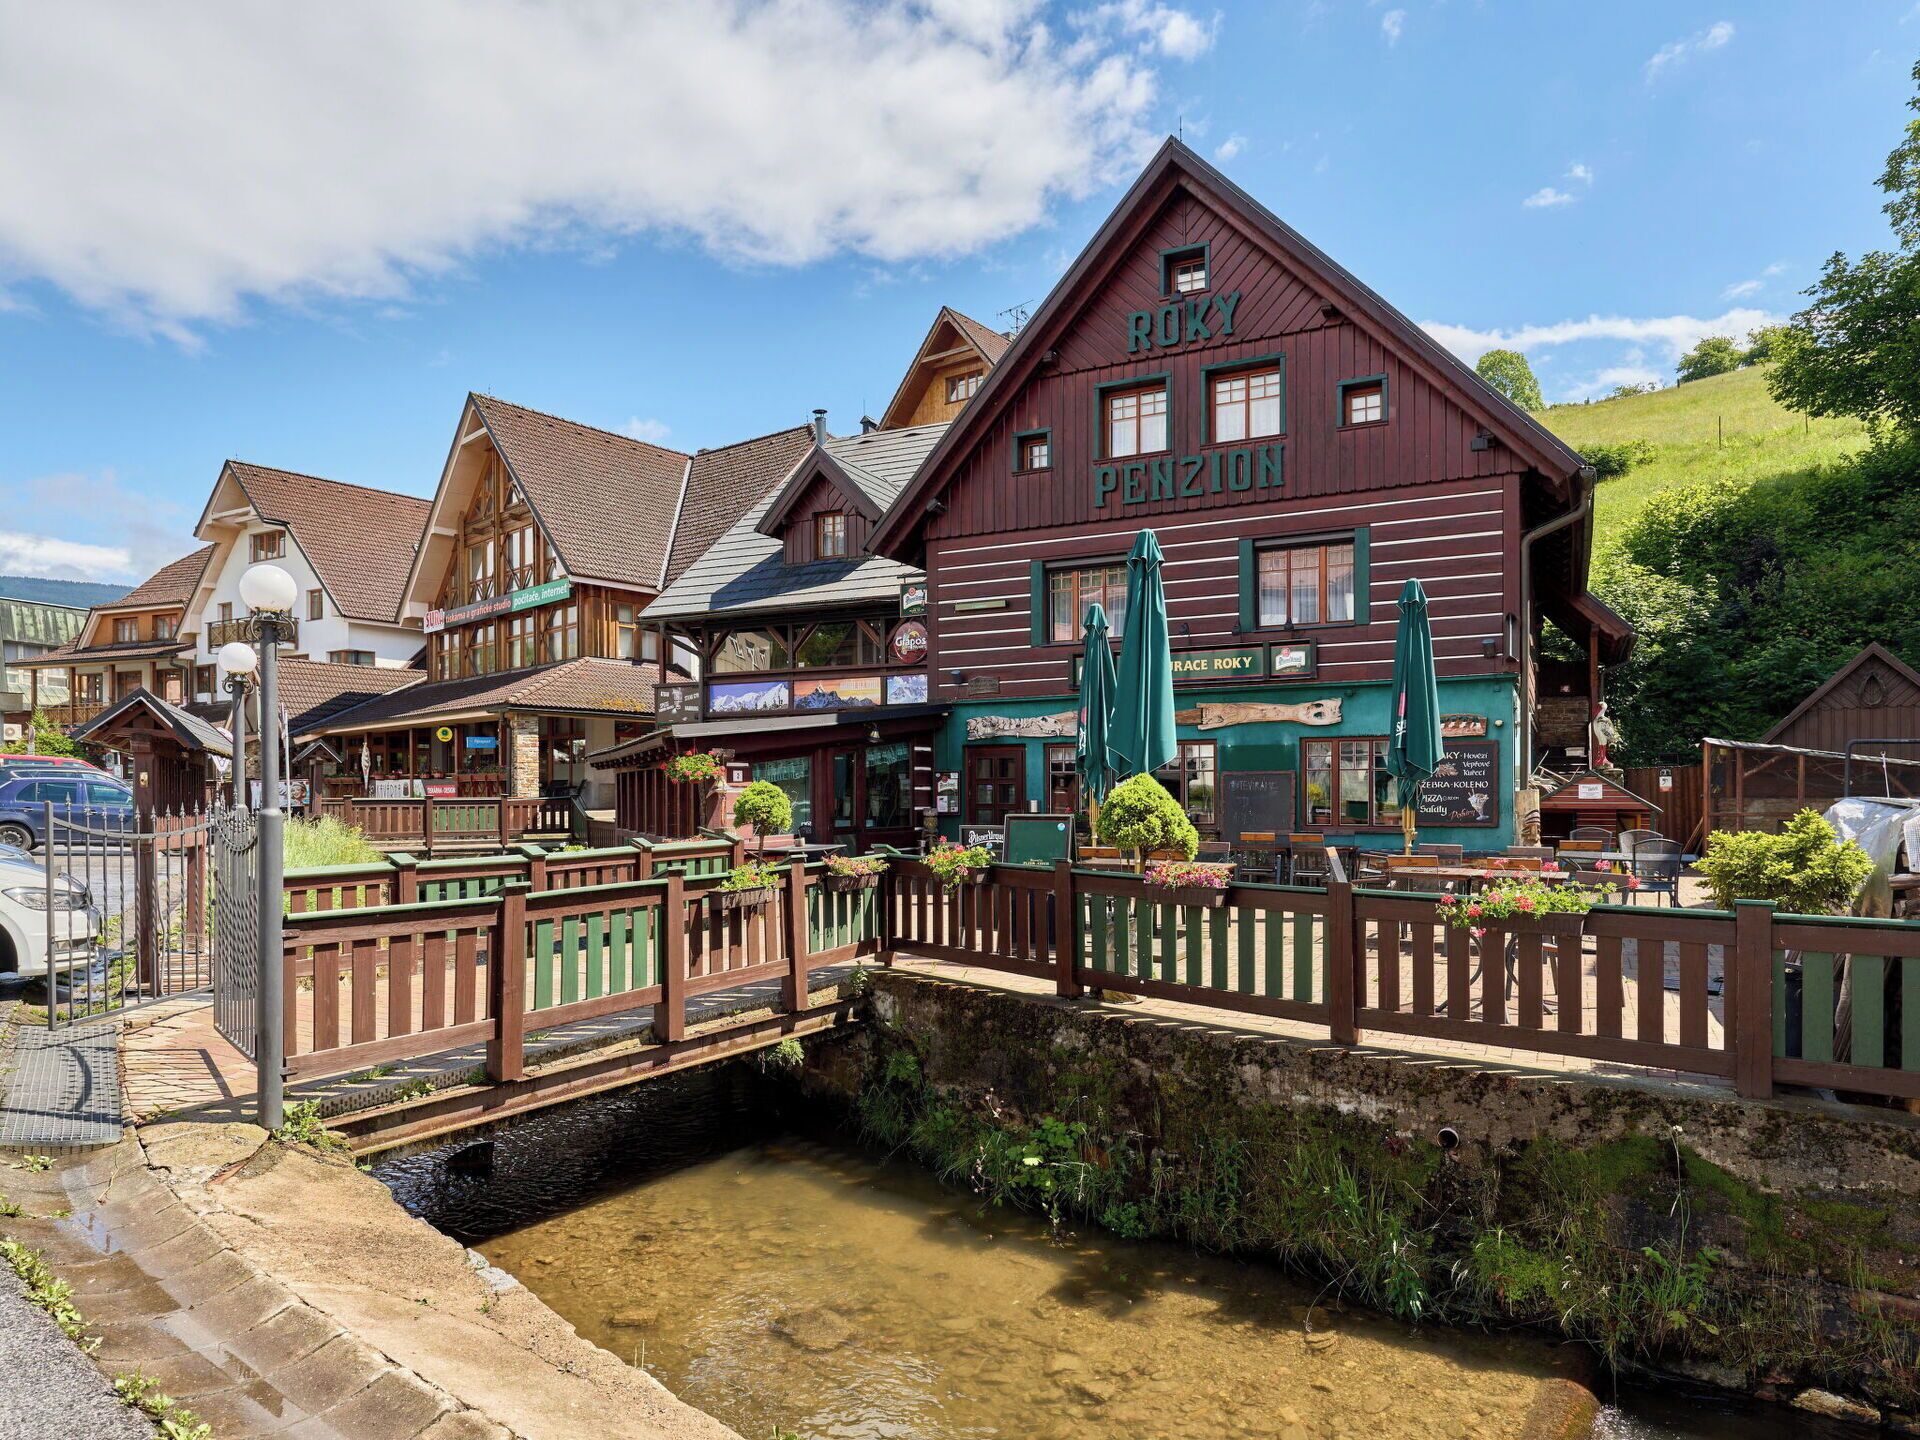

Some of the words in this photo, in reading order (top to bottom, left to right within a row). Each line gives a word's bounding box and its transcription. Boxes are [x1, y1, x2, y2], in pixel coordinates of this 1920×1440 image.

[1127, 290, 1241, 353] ROKY
[1093, 444, 1285, 508] PENZION
[446, 610, 466, 622] tiskárna
[471, 603, 494, 620] grafické
[493, 598, 512, 613] studio
[541, 581, 569, 600] internet
[1214, 656, 1253, 670] ROKY
